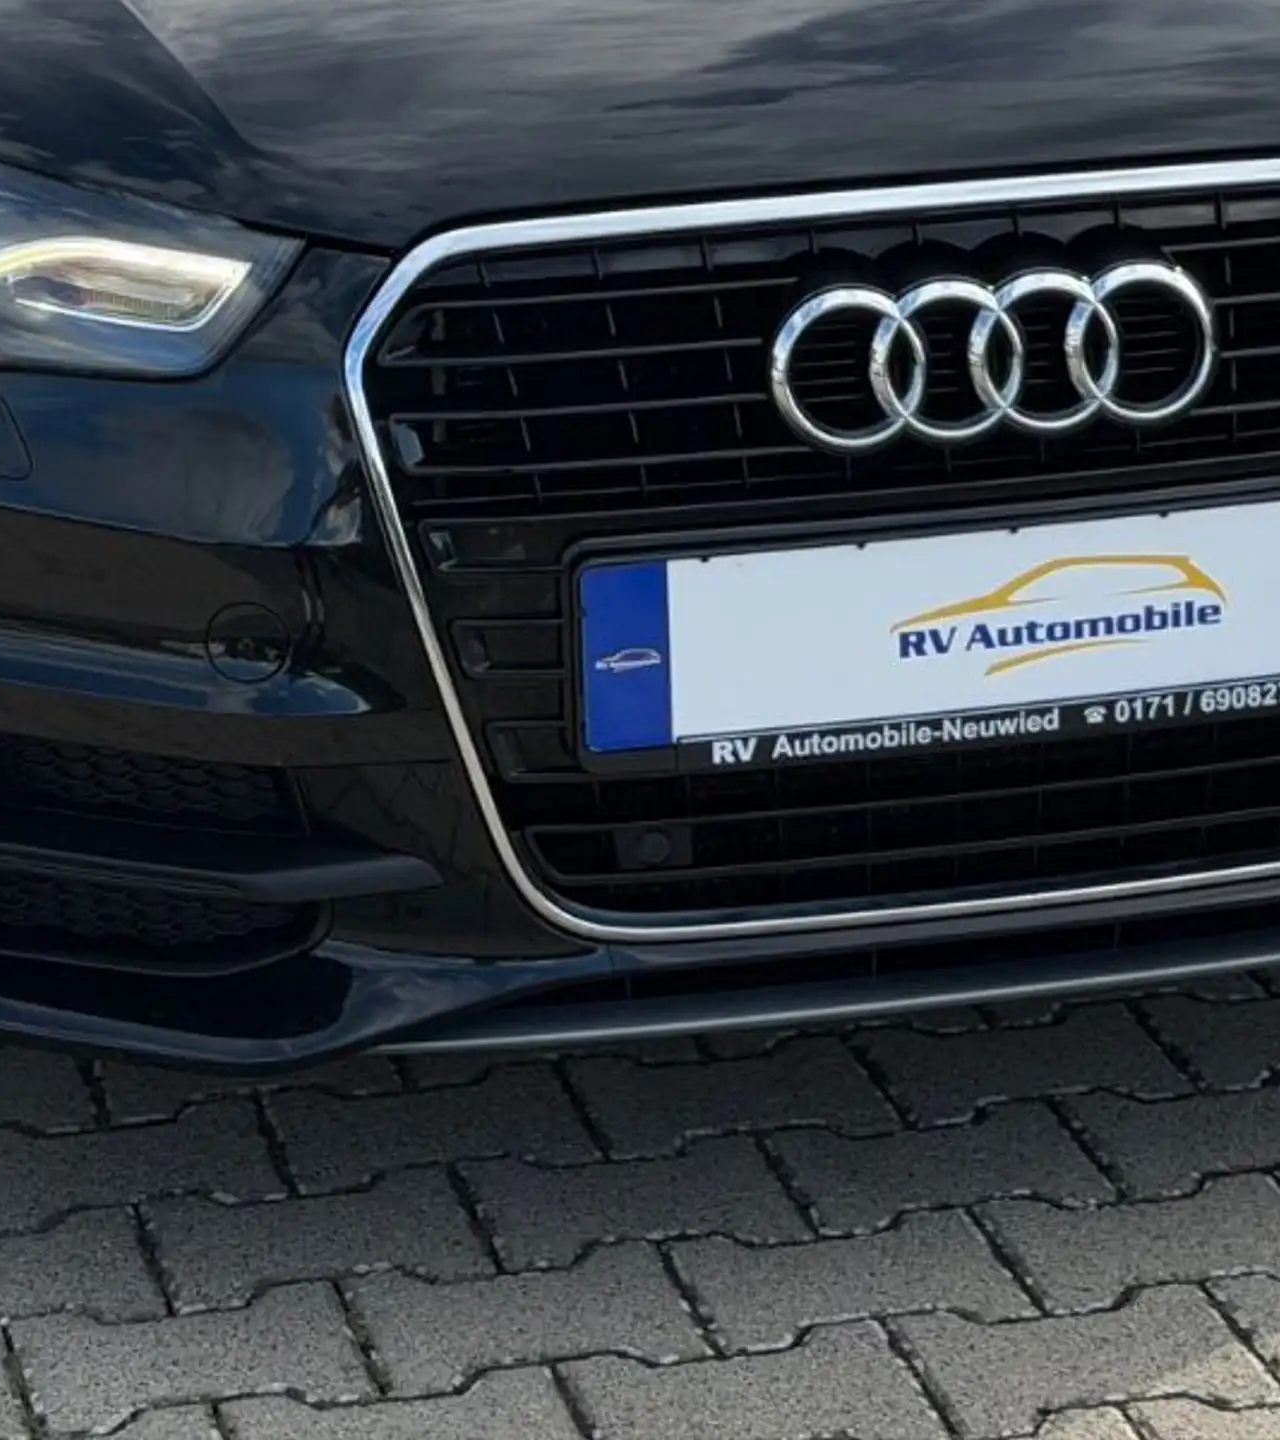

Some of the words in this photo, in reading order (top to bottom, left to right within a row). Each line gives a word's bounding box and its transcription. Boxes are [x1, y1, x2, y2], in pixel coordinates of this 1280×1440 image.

[899, 627, 957, 659] RV
[965, 601, 1222, 651] Automobile
[712, 737, 757, 765] RV
[772, 708, 1060, 760] Automobile-Neuwied
[1114, 695, 1175, 724] 0171
